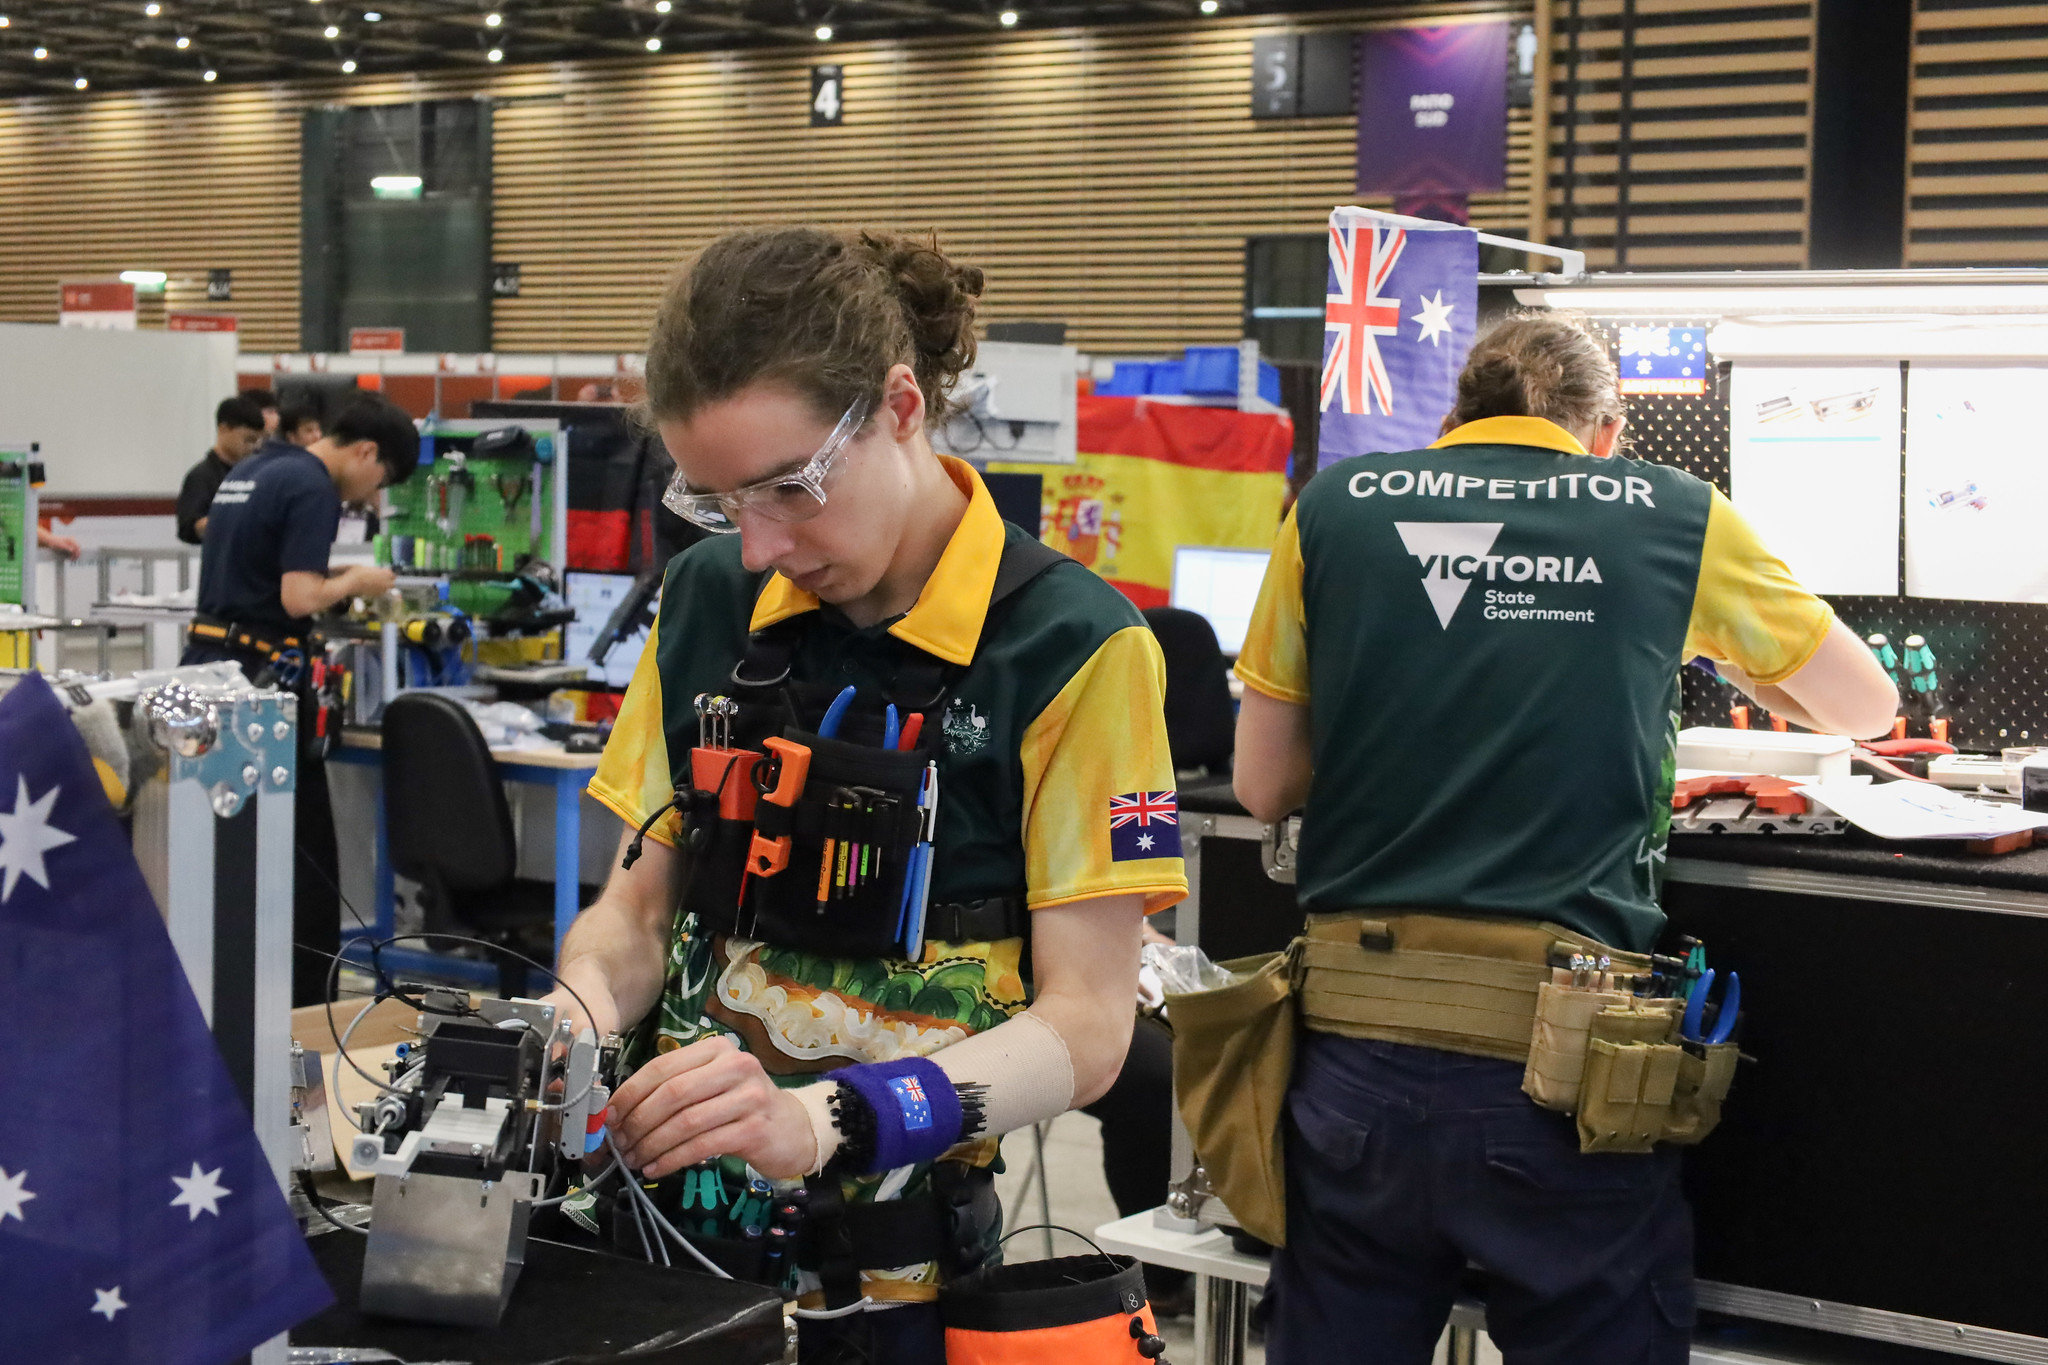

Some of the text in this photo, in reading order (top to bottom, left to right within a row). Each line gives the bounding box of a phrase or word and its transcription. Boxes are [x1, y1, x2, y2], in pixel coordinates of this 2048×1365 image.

[1263, 51, 1287, 90] 5
[814, 79, 840, 120] 4
[1348, 469, 1656, 508] COMPETITOR
[1417, 554, 1603, 583] VICTORIA
[1483, 605, 1595, 622] Government
[1484, 589, 1536, 604] State
